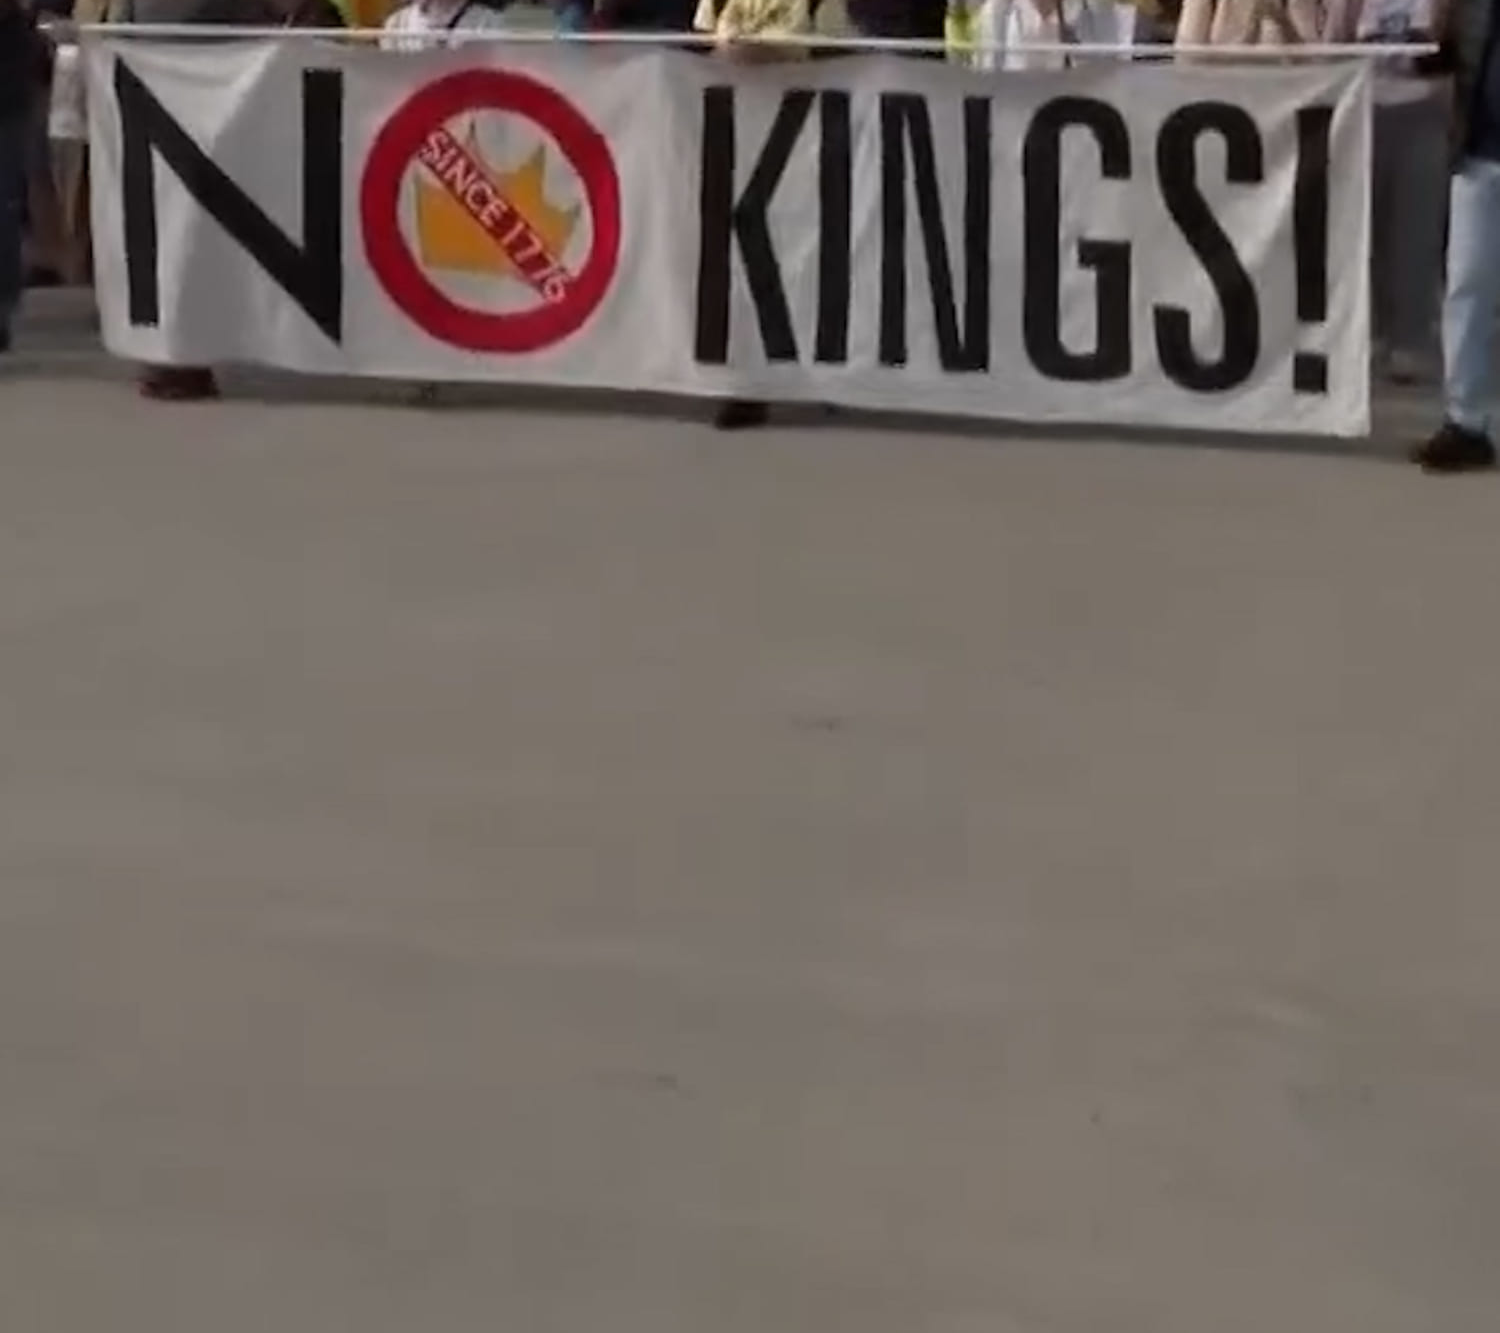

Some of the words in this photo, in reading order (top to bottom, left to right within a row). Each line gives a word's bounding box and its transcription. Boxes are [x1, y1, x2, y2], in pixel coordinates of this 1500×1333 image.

[418, 129, 508, 227] SINCE
[501, 221, 574, 303] 1776
[694, 85, 1334, 394] KINGS!
